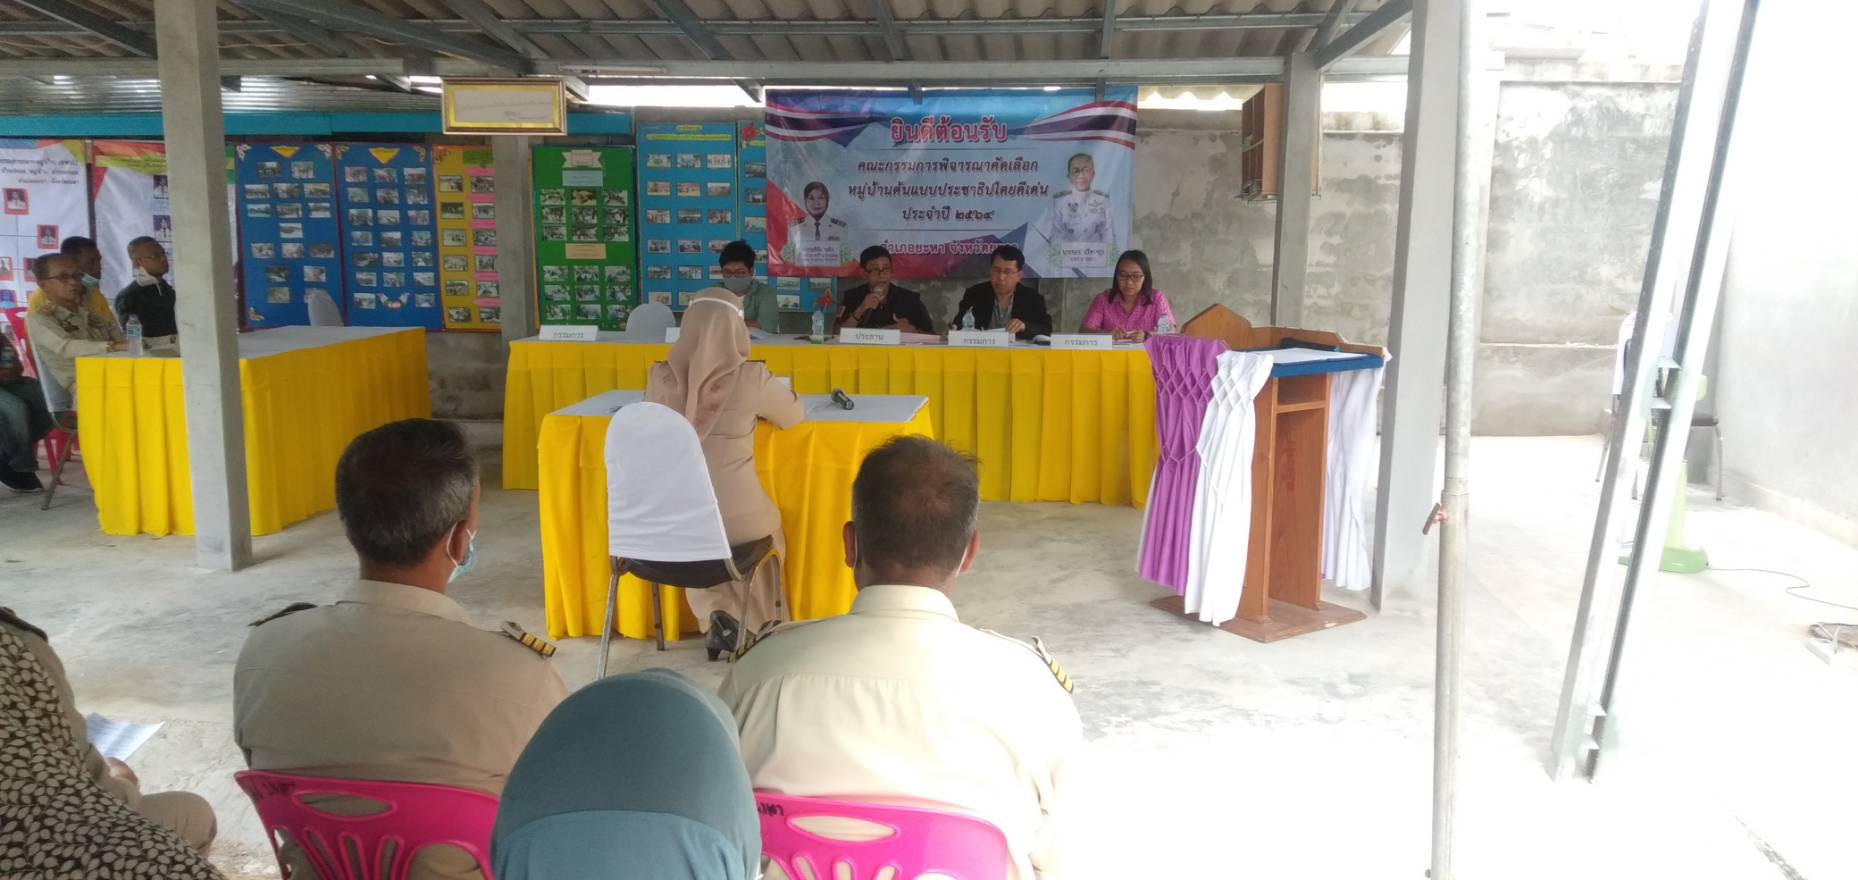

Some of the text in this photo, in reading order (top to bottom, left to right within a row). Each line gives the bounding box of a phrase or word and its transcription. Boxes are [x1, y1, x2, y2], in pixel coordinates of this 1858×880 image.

[890, 115, 1008, 143] ยินดีต้อนรับ
[858, 156, 1039, 173] คณะกรรมการพิจารณาคัดเลือก
[902, 205, 950, 221] ประจำปี
